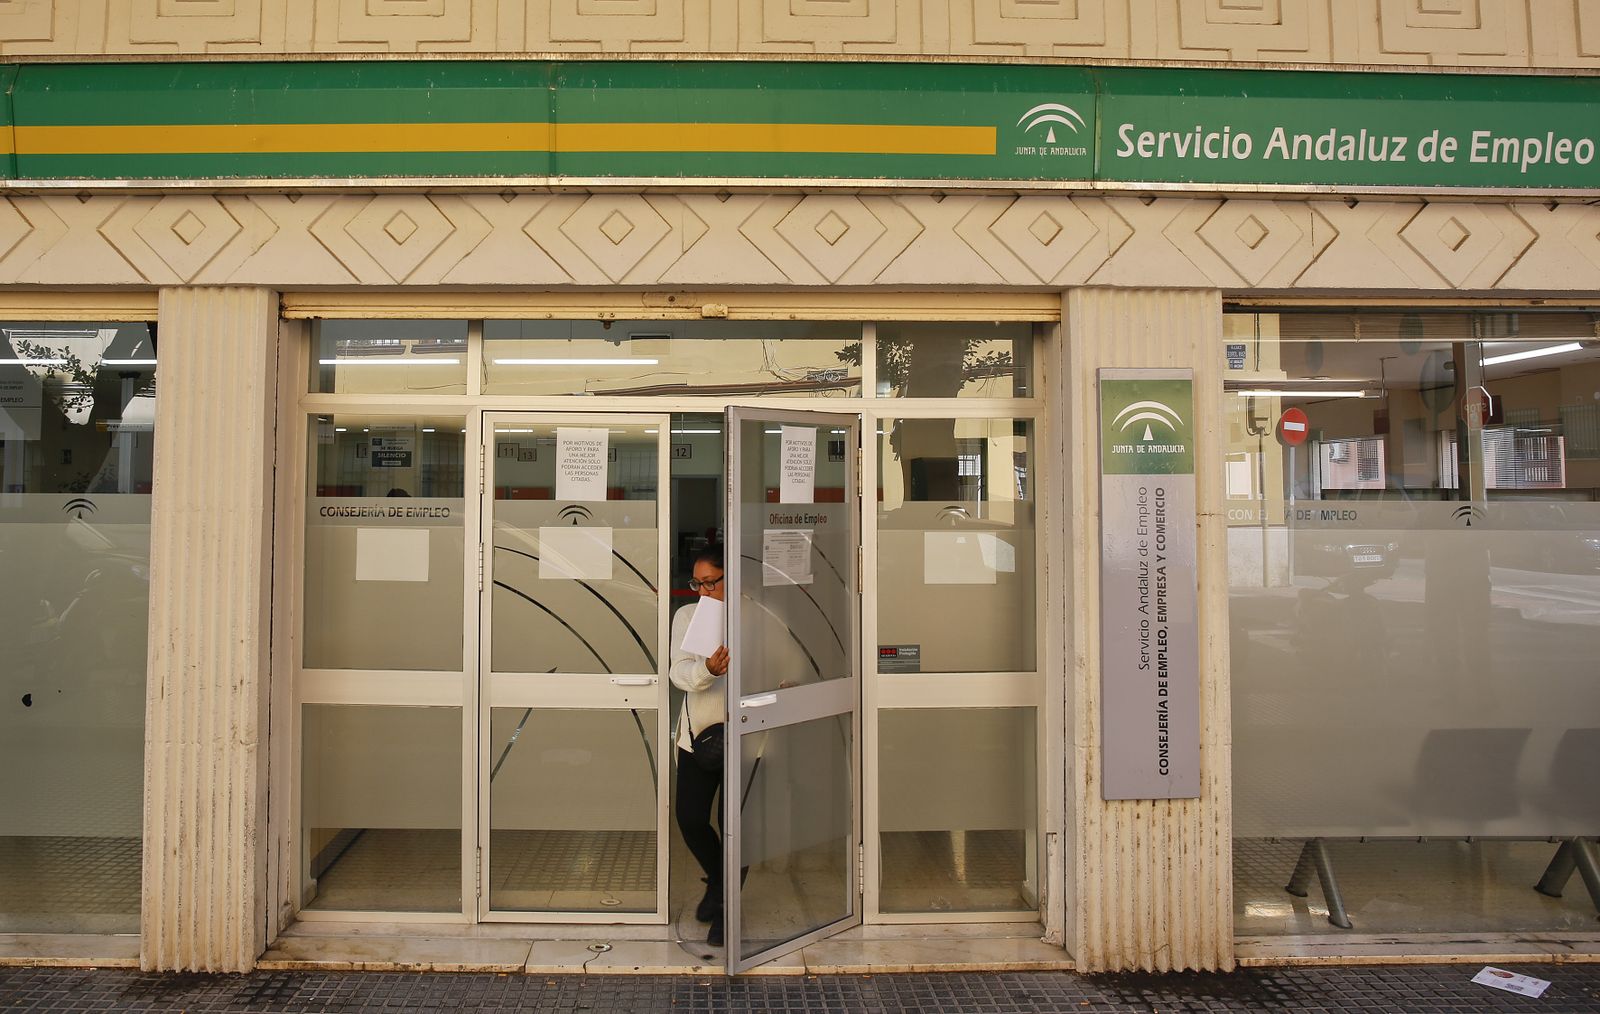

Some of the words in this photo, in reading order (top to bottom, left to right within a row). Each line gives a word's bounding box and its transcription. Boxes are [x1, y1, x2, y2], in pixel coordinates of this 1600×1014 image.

[1015, 146, 1036, 156] JUNTA
[1040, 147, 1048, 156] DE
[1116, 123, 1253, 160] Servicio
[1262, 127, 1408, 162] Andaluz
[1417, 129, 1458, 163] de
[1469, 130, 1595, 174] Empleo
[503, 447, 514, 457] 11
[523, 451, 533, 460] 13
[675, 447, 687, 457] 12
[1112, 444, 1134, 454] JUNTA
[1136, 444, 1145, 454] DE
[319, 503, 386, 518] CONSEJERÍA
[388, 506, 403, 518] DE
[406, 507, 450, 518] EMPLEO
[769, 512, 793, 525] Oficina
[794, 512, 803, 525] de
[803, 512, 828, 526] Empleo
[1136, 486, 1151, 536] Empleo
[1155, 487, 1166, 551] COMERCIO
[1296, 509, 1311, 521] DE
[1314, 509, 1358, 521] MPLEO
[1137, 539, 1149, 557] de
[1156, 554, 1166, 563] Y
[1137, 560, 1150, 615] Andaluz
[1156, 565, 1167, 623] EMPRESA
[1138, 619, 1150, 671] Servicio
[1157, 625, 1169, 678] EMPLEO,
[1157, 680, 1168, 697] DE
[1156, 699, 1169, 776] CONSEJERÍA
